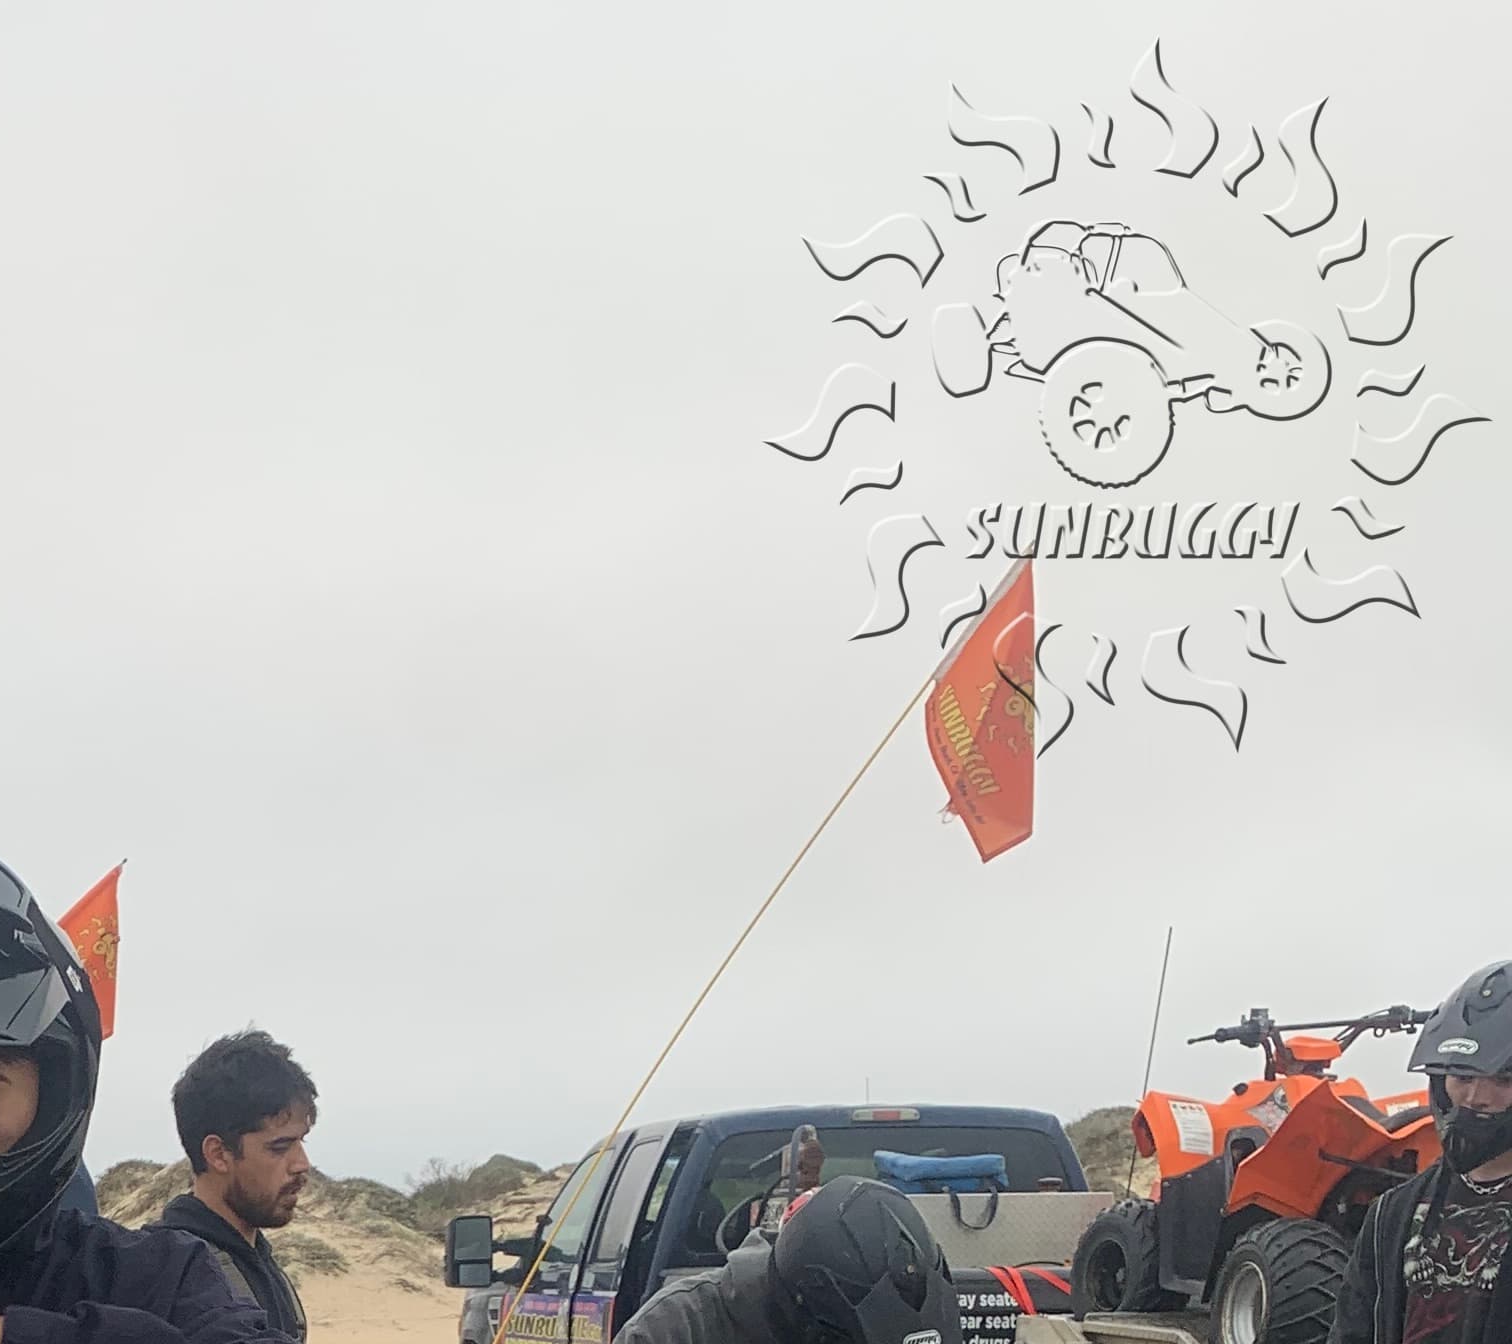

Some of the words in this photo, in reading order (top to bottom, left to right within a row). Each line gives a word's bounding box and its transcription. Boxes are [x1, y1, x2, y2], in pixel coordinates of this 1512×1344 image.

[956, 1293, 976, 1310] ay
[960, 1316, 983, 1329] ear
[985, 1313, 1017, 1329] seat
